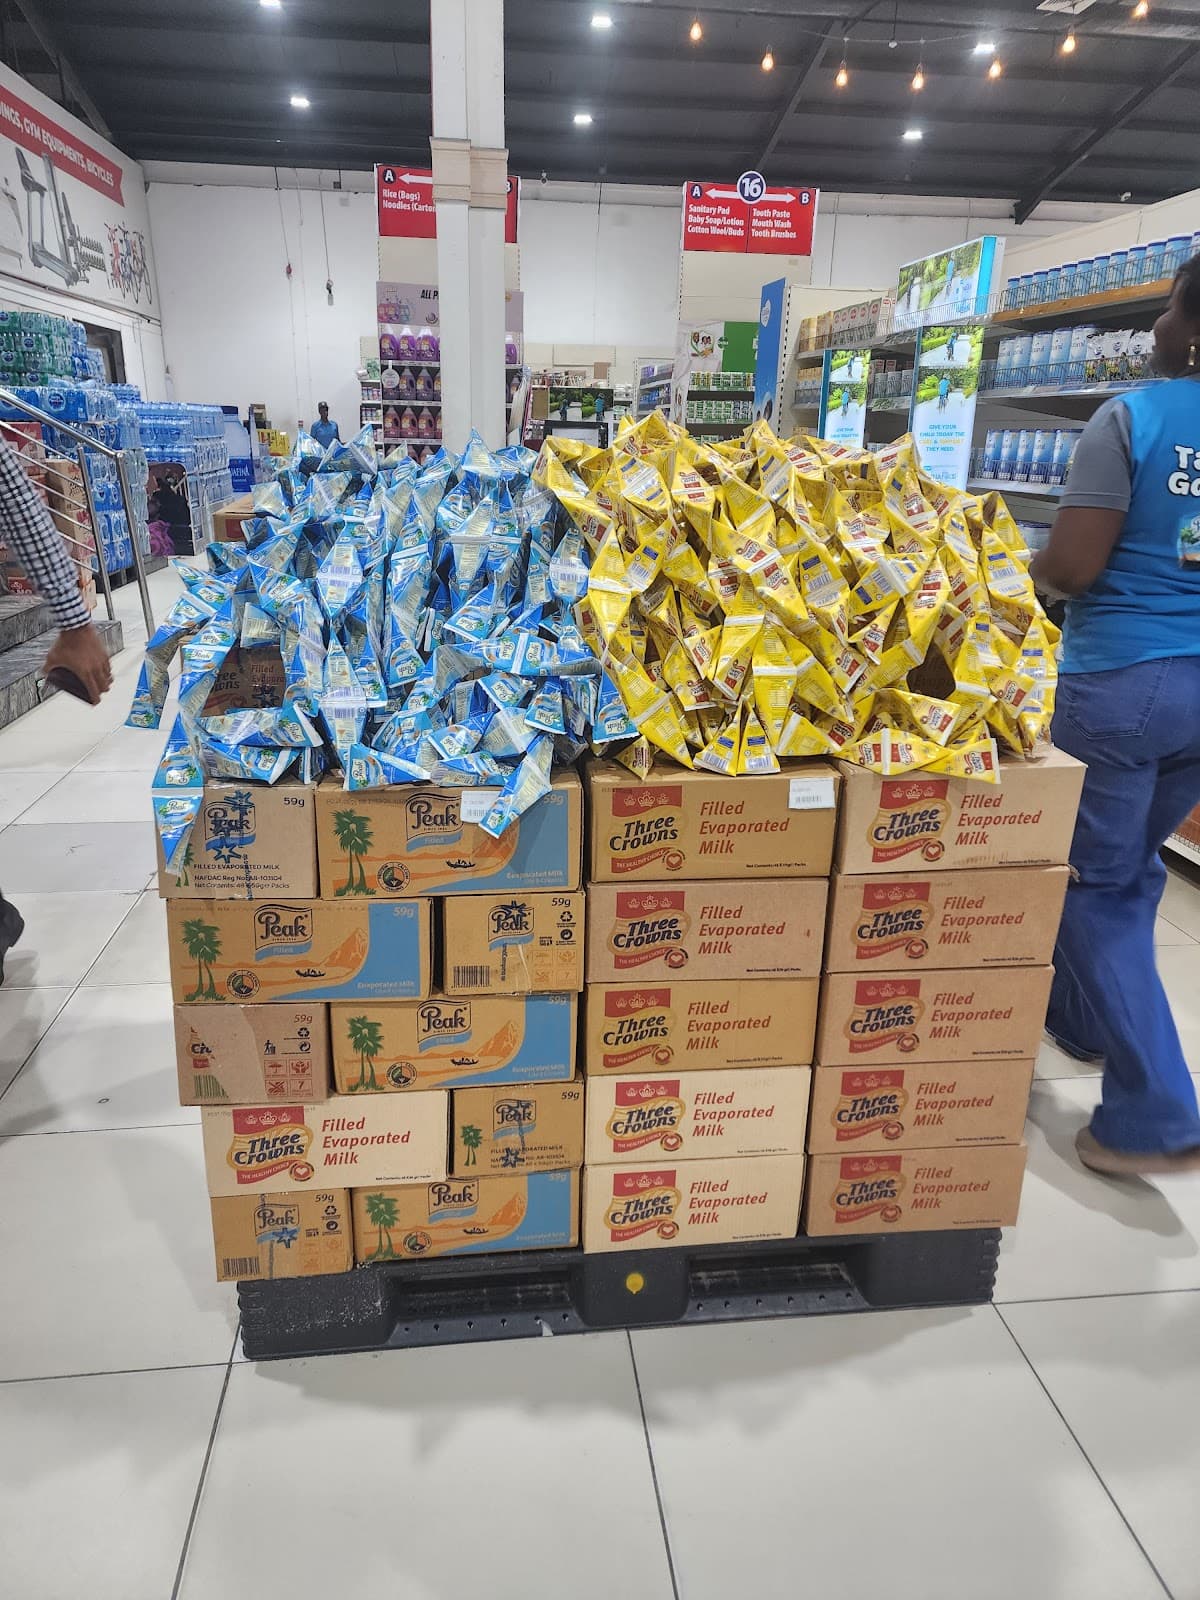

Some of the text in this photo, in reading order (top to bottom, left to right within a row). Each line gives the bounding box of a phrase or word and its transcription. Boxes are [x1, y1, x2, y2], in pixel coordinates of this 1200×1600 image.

[86, 158, 114, 186] BICYCLES
[385, 170, 393, 181] A
[383, 189, 420, 201] Rice (Bags)
[692, 186, 700, 196] A
[742, 178, 760, 197] 16
[383, 200, 410, 210] Noodles
[801, 193, 809, 203] B
[689, 204, 730, 215] Sanitary Pad
[753, 208, 790, 218] Tooth Paste
[688, 215, 744, 226] Baby Soap/Lotion
[752, 219, 791, 228] Mouth Wash
[688, 225, 744, 236] Cotton Wool/Buds
[752, 229, 796, 238] Tooth Brushes
[420, 290, 432, 299] ALL
[168, 801, 187, 812] Peak
[283, 797, 305, 807] 59g
[700, 801, 744, 816] Filled
[960, 794, 1004, 809] Filled
[410, 800, 458, 829] Peak
[889, 808, 940, 829] Three
[958, 810, 1042, 829] Evaporated
[624, 816, 675, 838] Three
[700, 818, 789, 837] Evaporated
[874, 818, 941, 841] Crowns
[609, 828, 678, 852] Crowns
[955, 831, 989, 846] Milk
[699, 840, 735, 855] Milk
[552, 898, 570, 907] 59g
[943, 896, 985, 910] Filled
[700, 905, 743, 920] Filled
[872, 908, 923, 928] Three
[258, 908, 414, 940] Peak 59g
[628, 918, 680, 937] Three
[941, 912, 1025, 930] Evaporated
[699, 922, 786, 937] Evaporated
[857, 919, 925, 940] Crowns
[613, 929, 682, 948] Crowns
[938, 932, 972, 944] Milk
[698, 942, 732, 955] Milk
[933, 992, 975, 1006] Filled
[420, 996, 567, 1033] Peak 59g
[688, 1000, 730, 1016] Filled
[864, 1004, 913, 1023] Three
[931, 1007, 1014, 1024] Evaporated
[294, 1014, 313, 1024] 59g
[617, 1015, 666, 1035] Three
[687, 1016, 771, 1034] Evaporated
[850, 1014, 916, 1034] Crowns
[603, 1025, 668, 1047] Crowns
[929, 1025, 962, 1039] Milk
[686, 1037, 720, 1050] Milk
[561, 1092, 579, 1100] 59g
[917, 1082, 957, 1095] Filled
[694, 1092, 735, 1105] Filled
[850, 1094, 897, 1113] Three
[915, 1095, 994, 1111] Evaporated
[626, 1105, 674, 1124] Three
[693, 1105, 775, 1124] Evaporated
[836, 1103, 900, 1123] Crowns
[912, 1114, 945, 1127] Milk
[322, 1117, 366, 1132] Filled
[612, 1115, 677, 1135] Crowns
[692, 1125, 724, 1137] Milk
[248, 1132, 301, 1153] Three
[322, 1130, 411, 1149] Evaporated
[234, 1143, 306, 1166] Crowns
[323, 1152, 359, 1166] Milk
[914, 1167, 953, 1180] Filled
[431, 1183, 474, 1206] Peak
[689, 1180, 729, 1194] Filled
[849, 1179, 896, 1198] Three
[913, 1181, 990, 1197] Evaporated
[624, 1195, 671, 1214] Three
[688, 1192, 768, 1210] Evaporated
[835, 1188, 898, 1207] Crowns
[910, 1197, 942, 1210] Milk
[257, 1194, 334, 1229] Peak 59g
[610, 1205, 674, 1225] Crowns
[688, 1212, 719, 1225] Milk
